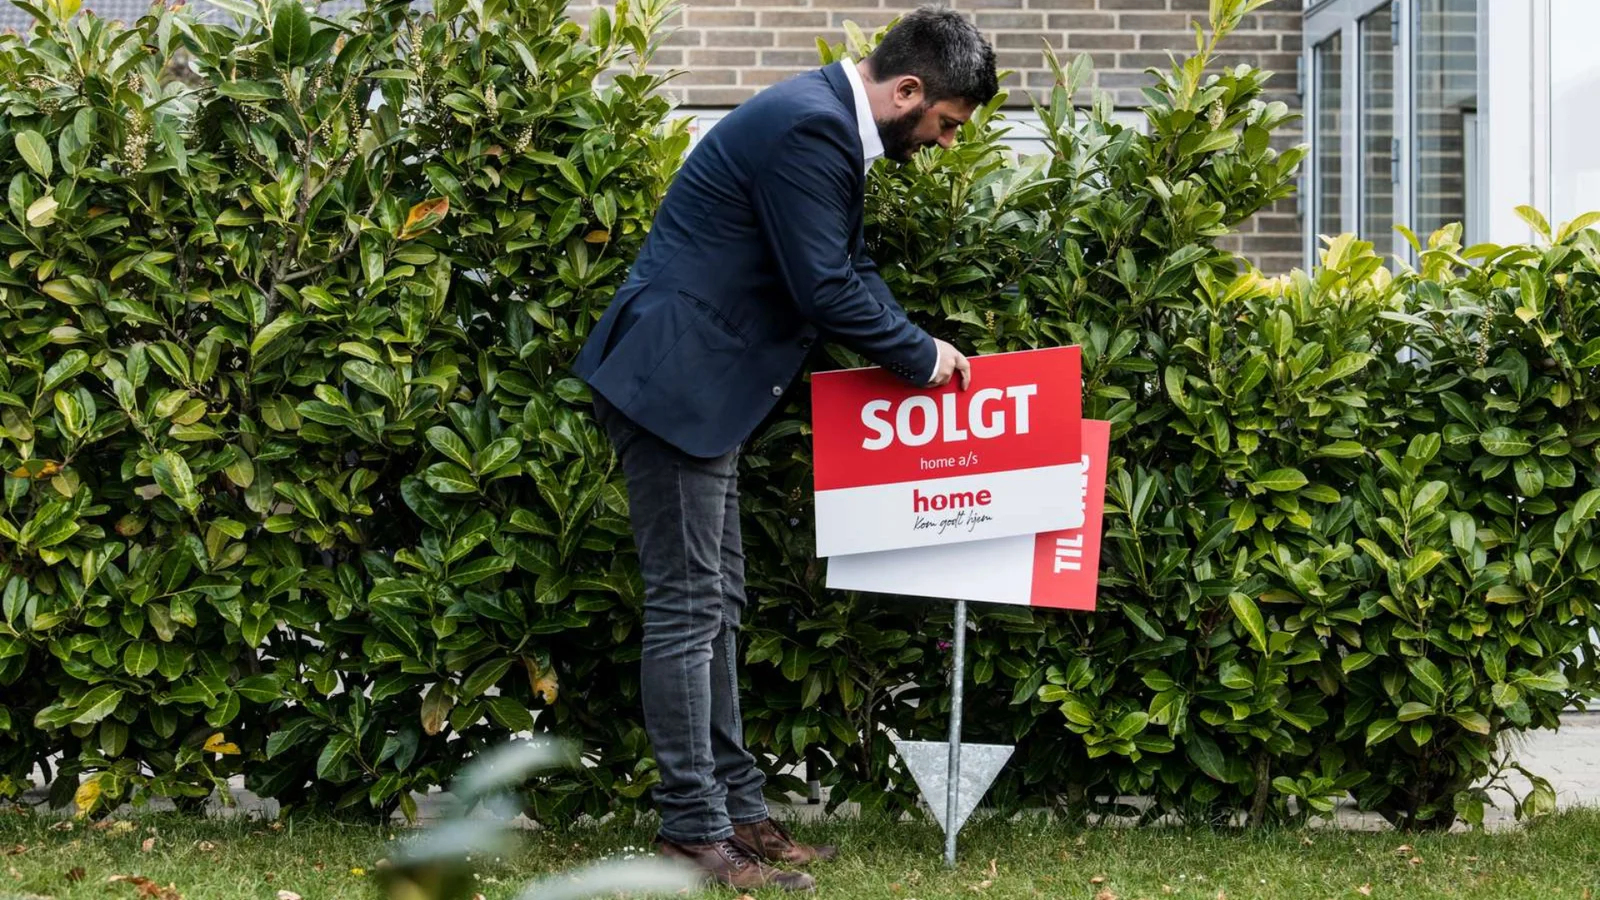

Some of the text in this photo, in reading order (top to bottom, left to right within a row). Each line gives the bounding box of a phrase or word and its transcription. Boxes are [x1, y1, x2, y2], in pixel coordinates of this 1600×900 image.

[860, 384, 1038, 451] SOLGT
[920, 451, 979, 470] home a/s
[913, 489, 992, 513] home
[913, 510, 992, 535] Kom godt hjem
[1054, 534, 1083, 574] TIL
